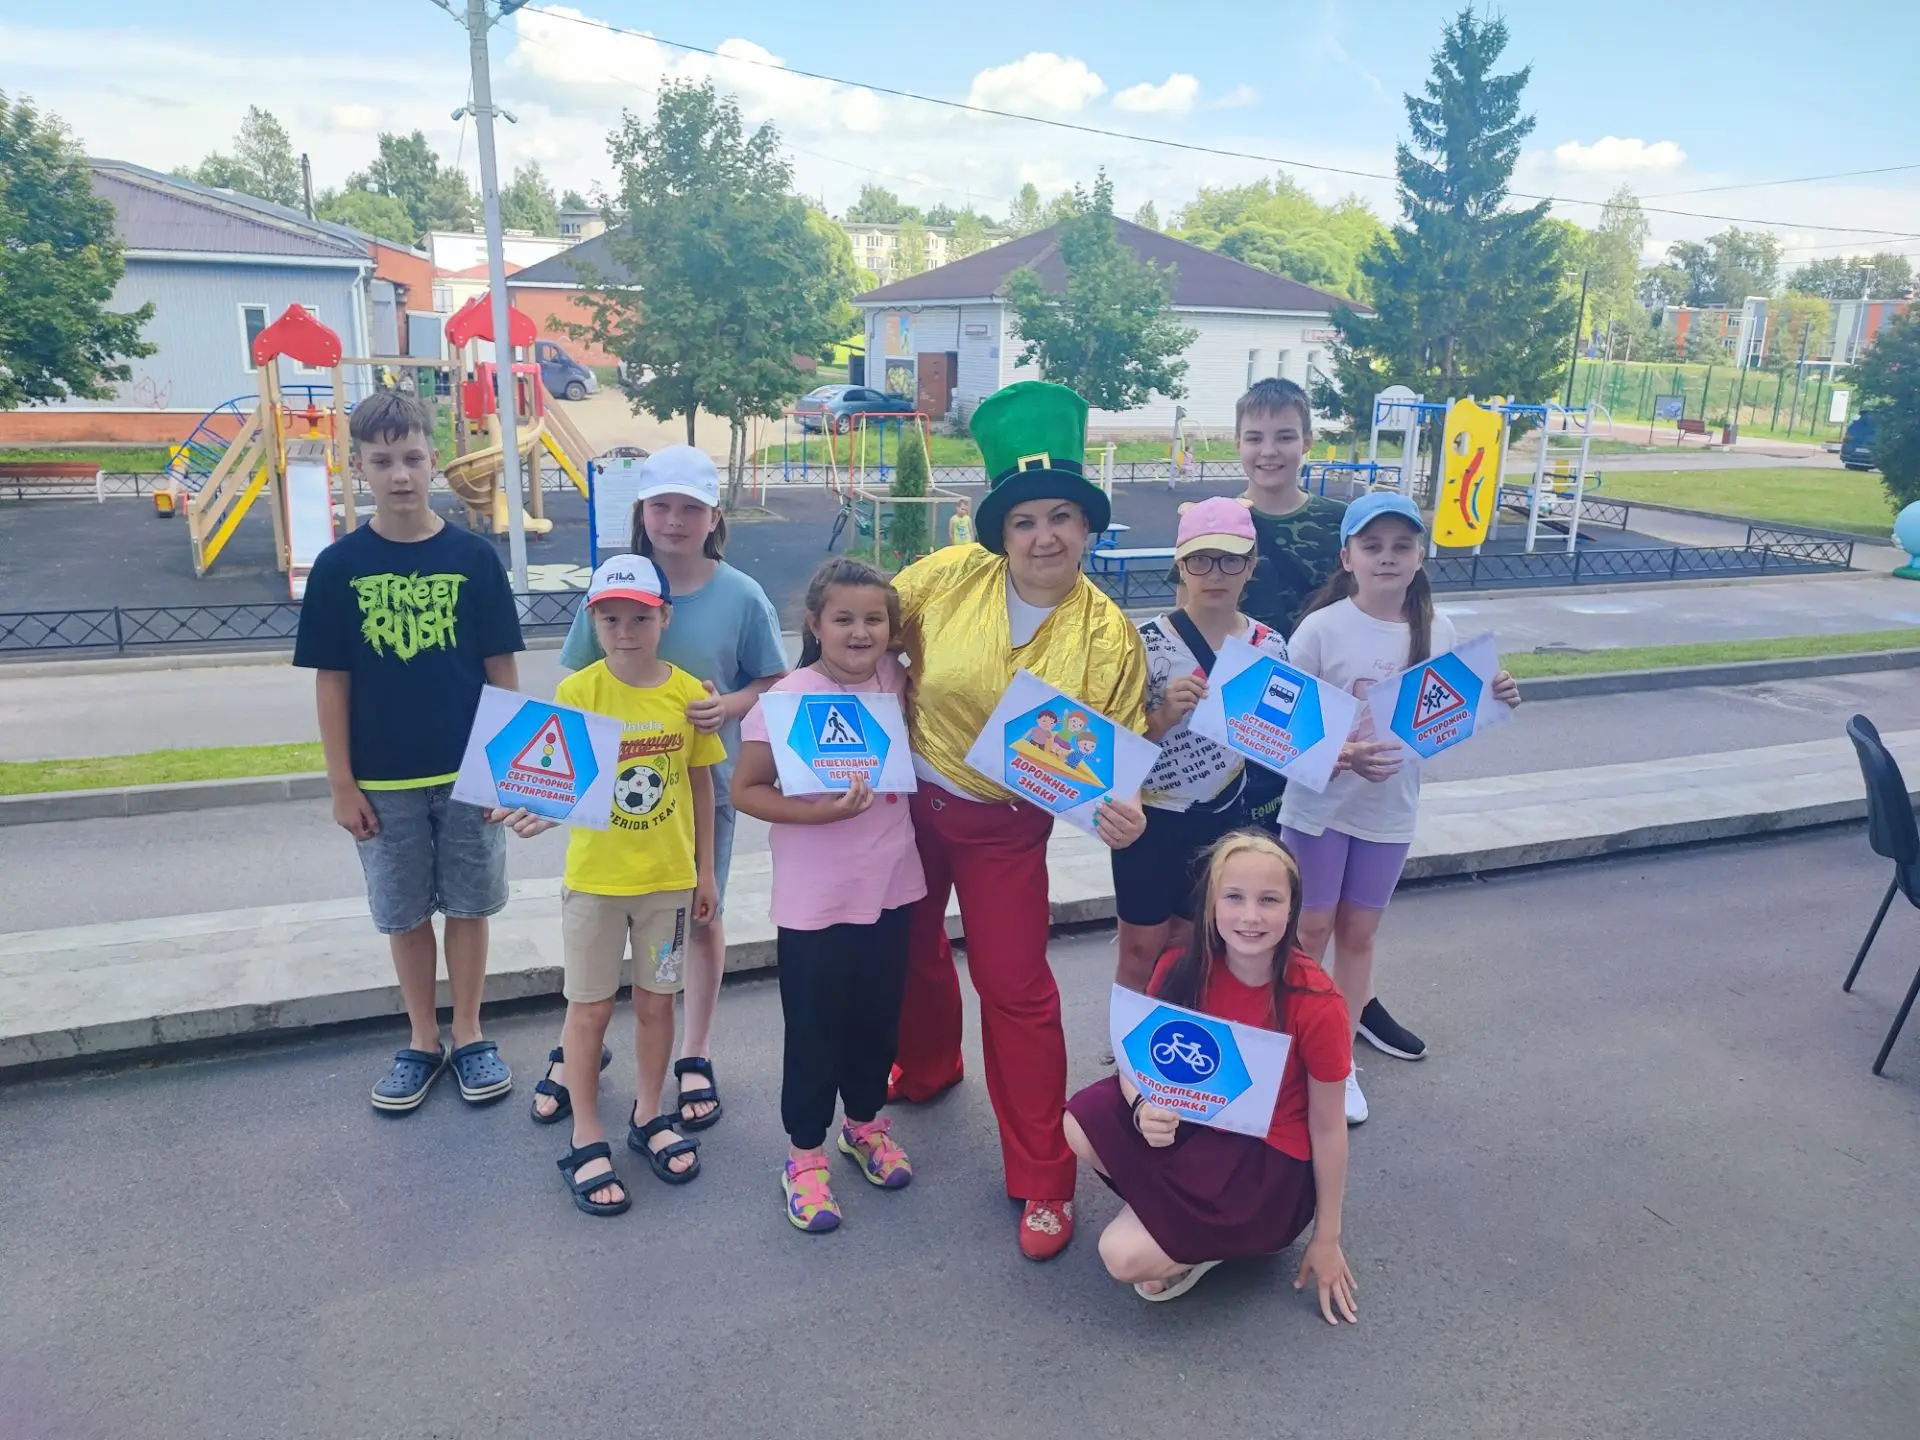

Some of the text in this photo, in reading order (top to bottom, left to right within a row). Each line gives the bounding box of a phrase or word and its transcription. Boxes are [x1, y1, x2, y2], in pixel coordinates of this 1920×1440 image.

[607, 572, 636, 583] FILA
[361, 602, 458, 665] RUSH
[1228, 718, 1298, 756] ОБЩЕСТВЕННОГО
[1242, 713, 1291, 741] ОСТАНОВКА
[1436, 728, 1457, 745] ДЕТИ
[1234, 732, 1286, 762] ТРАНСПОРТА
[814, 756, 878, 768] ПЕШЕХОДНЫЙ
[507, 770, 574, 791] СВЕТОФОРНОЕ
[1011, 757, 1079, 800] ДОРОЖНЫЕ
[1186, 769, 1211, 784] what
[498, 781, 576, 804] РЕГУЛИРОВАНИЕ
[1018, 776, 1057, 803] ЗНАКИ
[1137, 1071, 1226, 1105] ВЕЛОСИПЕДНАЯ
[1151, 1093, 1207, 1113] ДОРОЖКА
